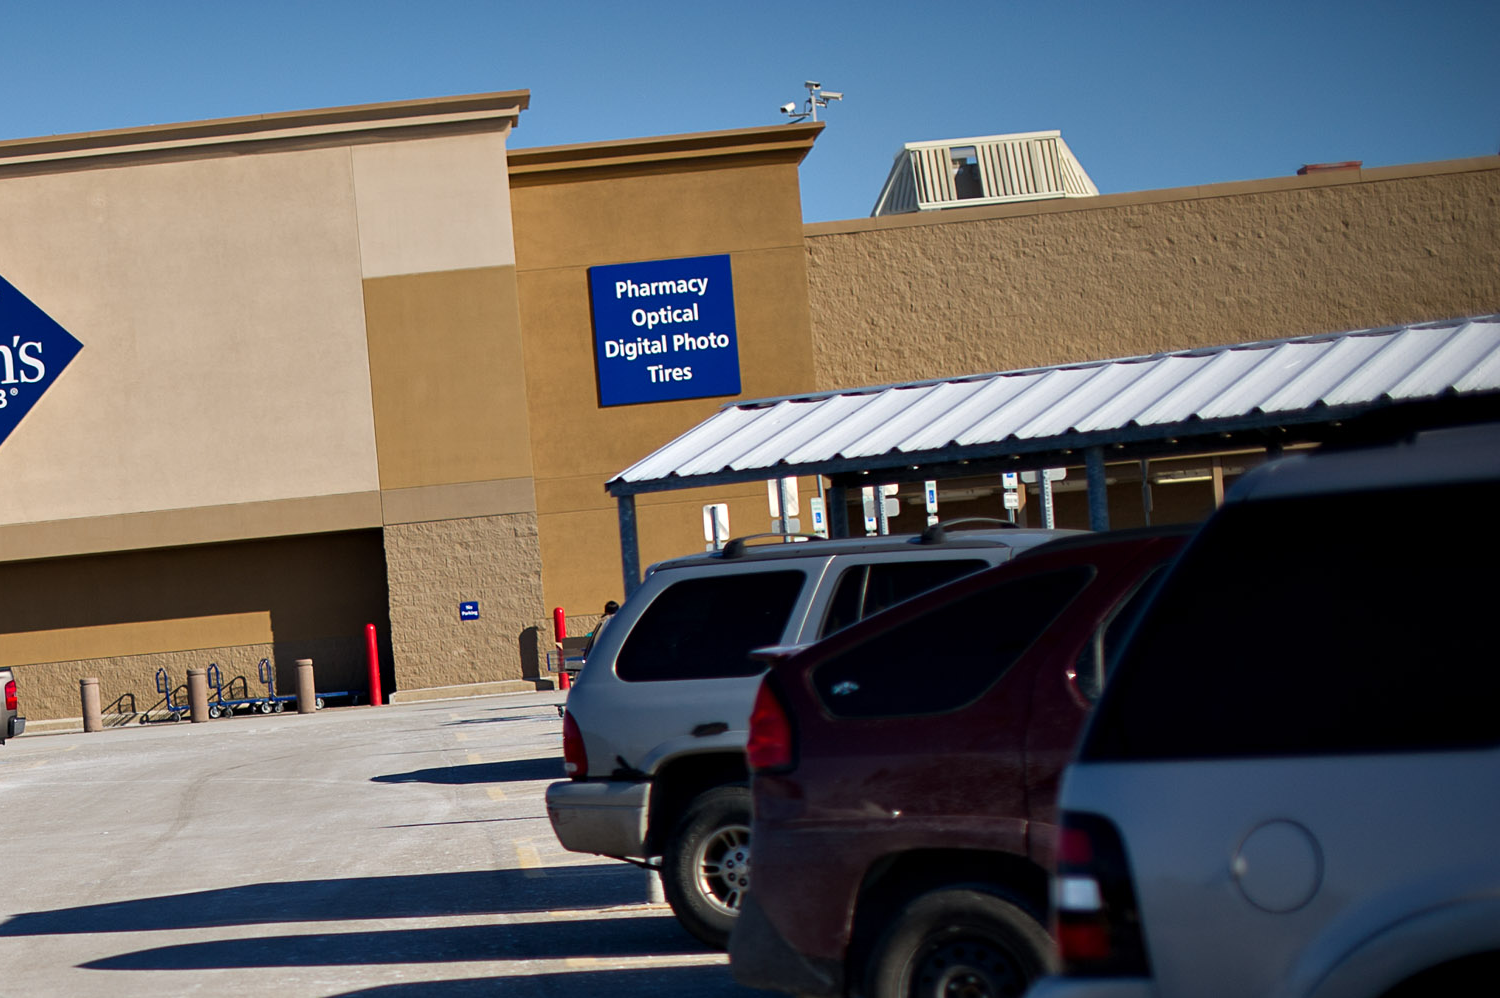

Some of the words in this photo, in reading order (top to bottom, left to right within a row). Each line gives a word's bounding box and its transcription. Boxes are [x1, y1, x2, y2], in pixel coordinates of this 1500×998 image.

[615, 277, 708, 299] Pharmacy
[631, 303, 699, 329] Optical
[604, 334, 668, 361] Digital
[672, 332, 730, 352] Photo
[646, 364, 693, 383] Tires
